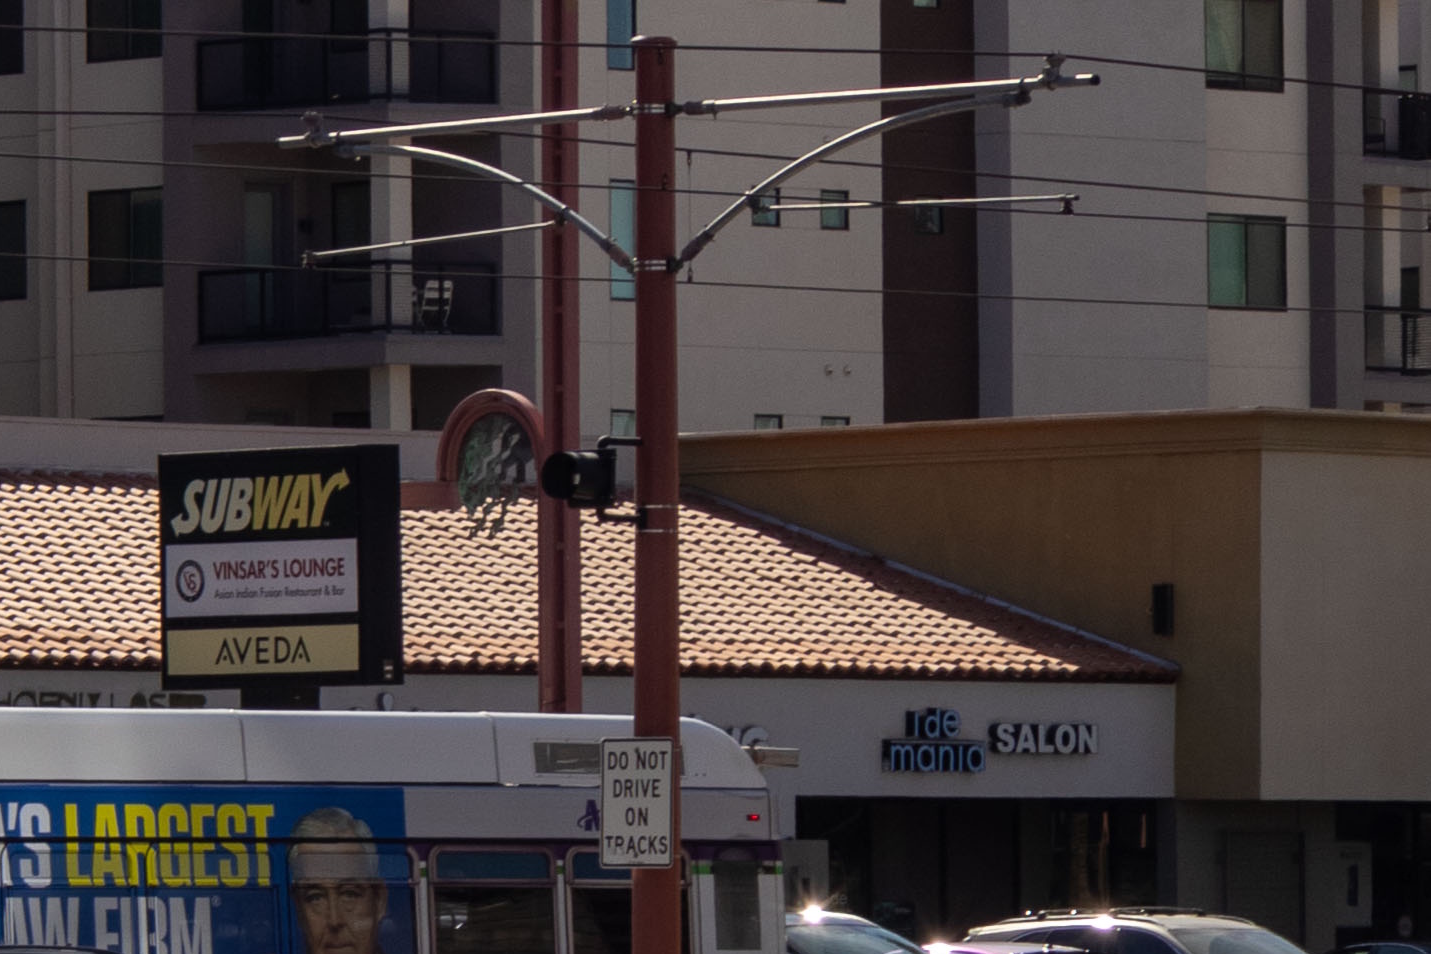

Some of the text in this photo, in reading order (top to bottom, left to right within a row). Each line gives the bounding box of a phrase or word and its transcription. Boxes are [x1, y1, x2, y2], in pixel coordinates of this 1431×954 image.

[170, 467, 350, 537] SUBWAY
[213, 557, 346, 580] VINSAR'S LOUNGE
[215, 636, 311, 665] AVEDA
[996, 723, 1098, 754] SALON
[608, 750, 668, 770] DO NOT
[613, 779, 661, 798] DRIVE
[625, 807, 649, 826] ON
[64, 803, 275, 887] LARGEST
[605, 836, 668, 855] TRACKS
